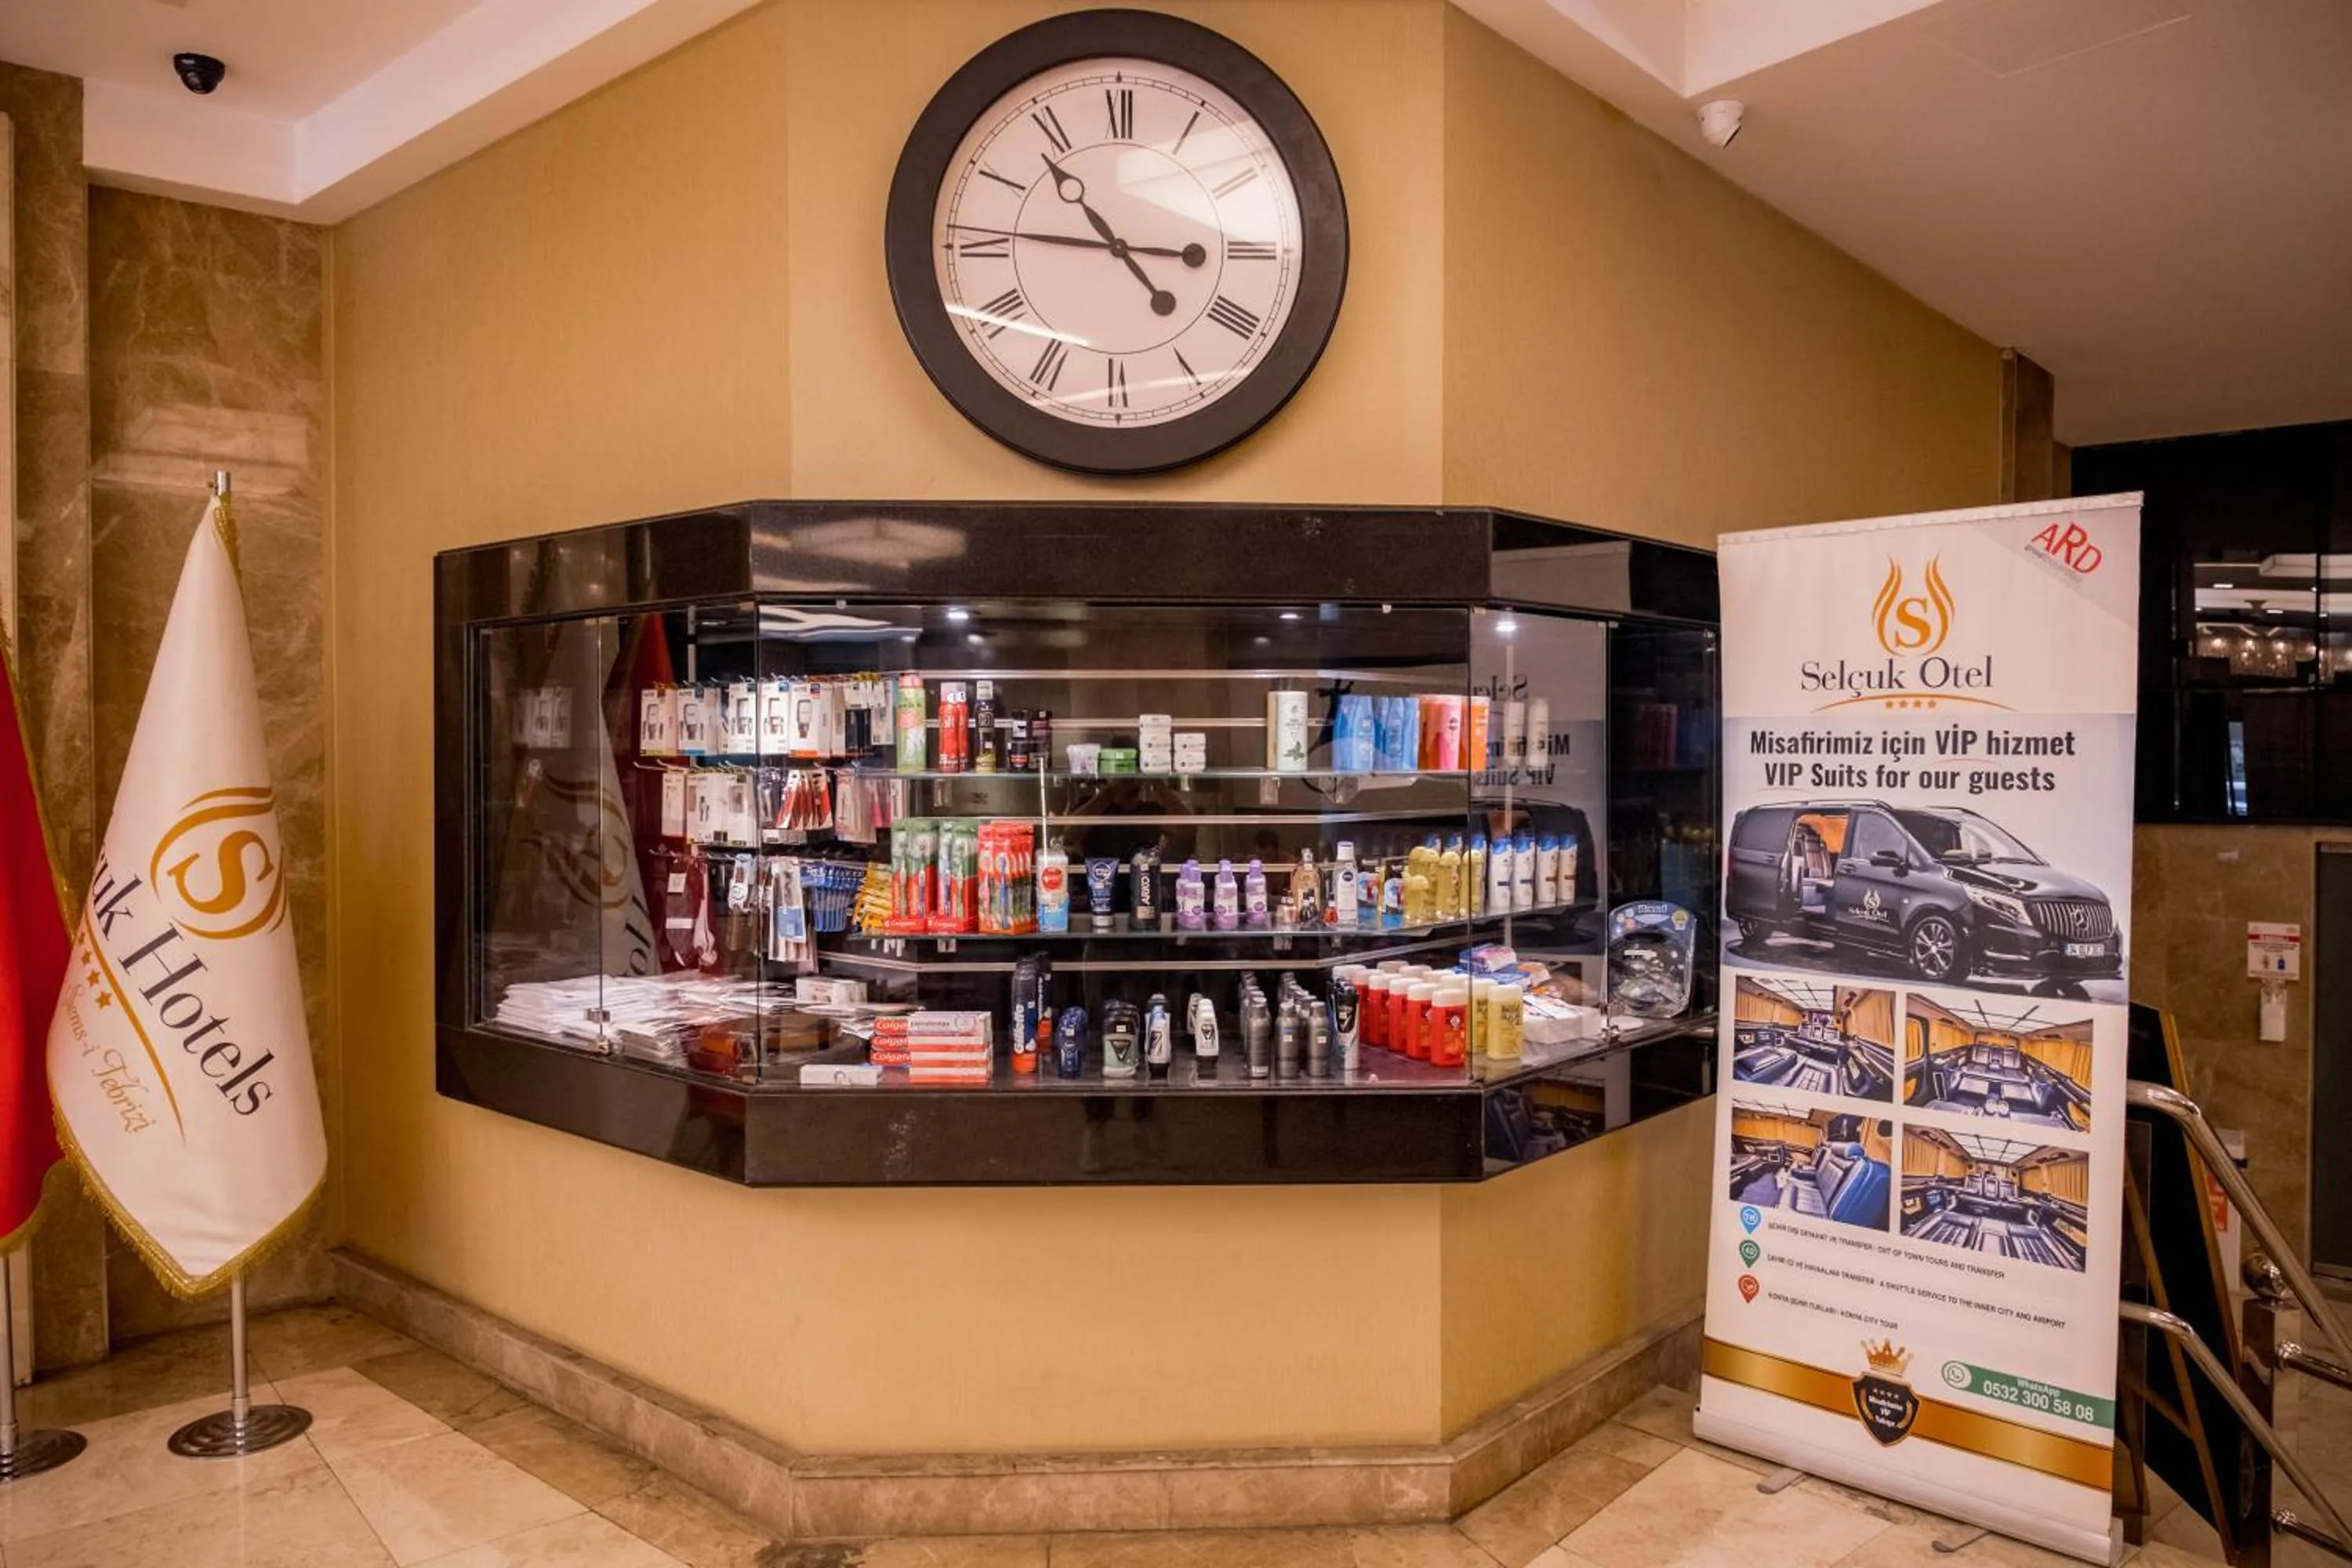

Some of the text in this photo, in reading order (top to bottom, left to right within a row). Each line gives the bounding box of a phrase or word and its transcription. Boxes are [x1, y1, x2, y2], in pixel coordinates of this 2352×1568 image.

[1105, 89, 1133, 139] XII
[2032, 521, 2102, 573] ARD
[1895, 598, 1930, 648] S
[1801, 656, 1992, 697] Selçuk Otel
[1751, 723, 2075, 761] Misafirimiz için VİP hizmet
[1766, 763, 2056, 793] VIP Suits for our guests
[117, 920, 275, 1116] Hotels
[91, 1047, 156, 1133] Tebrizi
[1878, 1246, 1891, 1255] OUT
[1904, 1251, 1924, 1261] TOWN
[1926, 1256, 1948, 1268] TOURS
[1950, 1261, 1965, 1271] AND
[1967, 1264, 2005, 1279] TRANSFER
[1864, 1316, 1878, 1325] CITY
[1880, 1319, 1898, 1330] TOUR
[1886, 1282, 1915, 1294] SHUTTLE
[1917, 1288, 1947, 1302] SERVICE
[1947, 1295, 1957, 1304] TO
[1959, 1298, 1973, 1308] THE
[1974, 1303, 1996, 1313] INNER
[1998, 1308, 2013, 1317] CITY
[2016, 1312, 2031, 1322] AND
[2033, 1315, 2066, 1329] AIRPORT
[1983, 1381, 2094, 1421] 0532 300 58 08
[2016, 1378, 2060, 1397] WhatsApp
